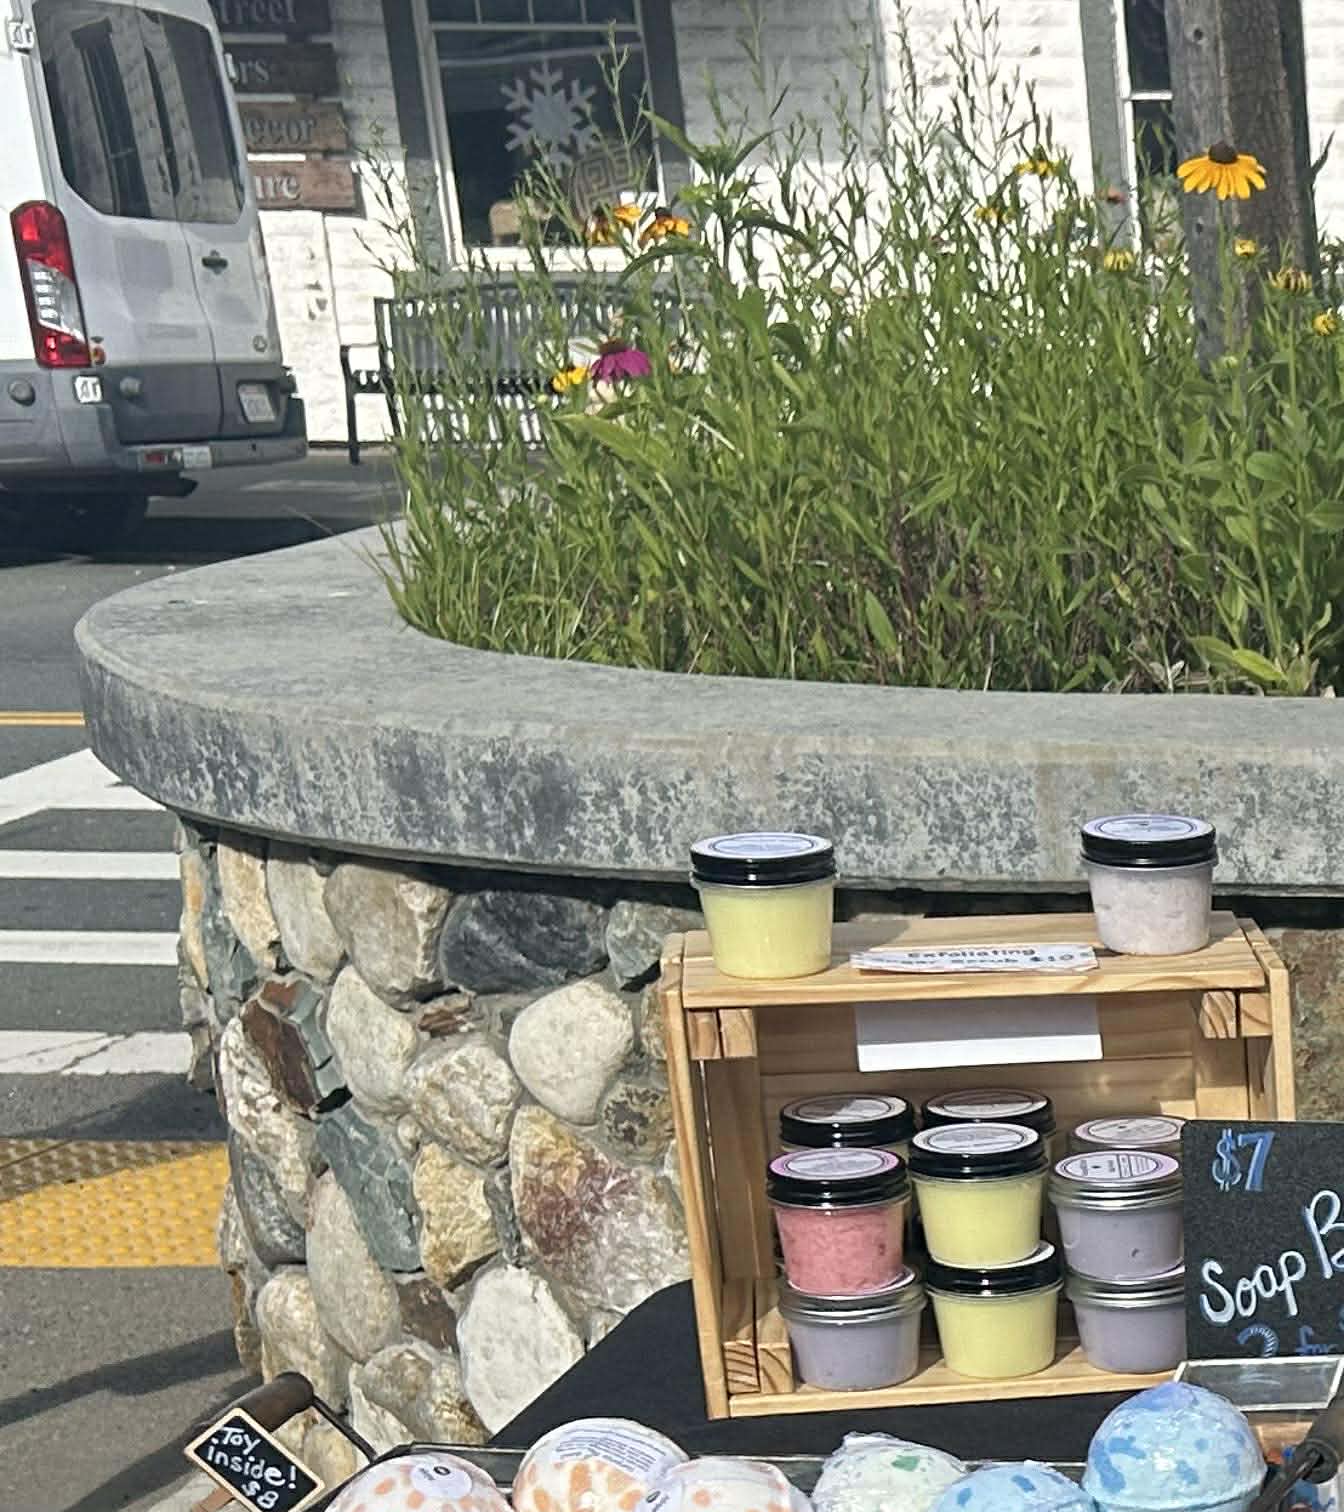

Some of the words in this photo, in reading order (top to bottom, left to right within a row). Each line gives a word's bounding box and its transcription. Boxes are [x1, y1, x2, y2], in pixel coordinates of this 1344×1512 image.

[1211, 1127, 1276, 1192] $7
[1200, 1250, 1307, 1324] Soap
[221, 1426, 262, 1456] Toy
[241, 1480, 280, 1510] $8
